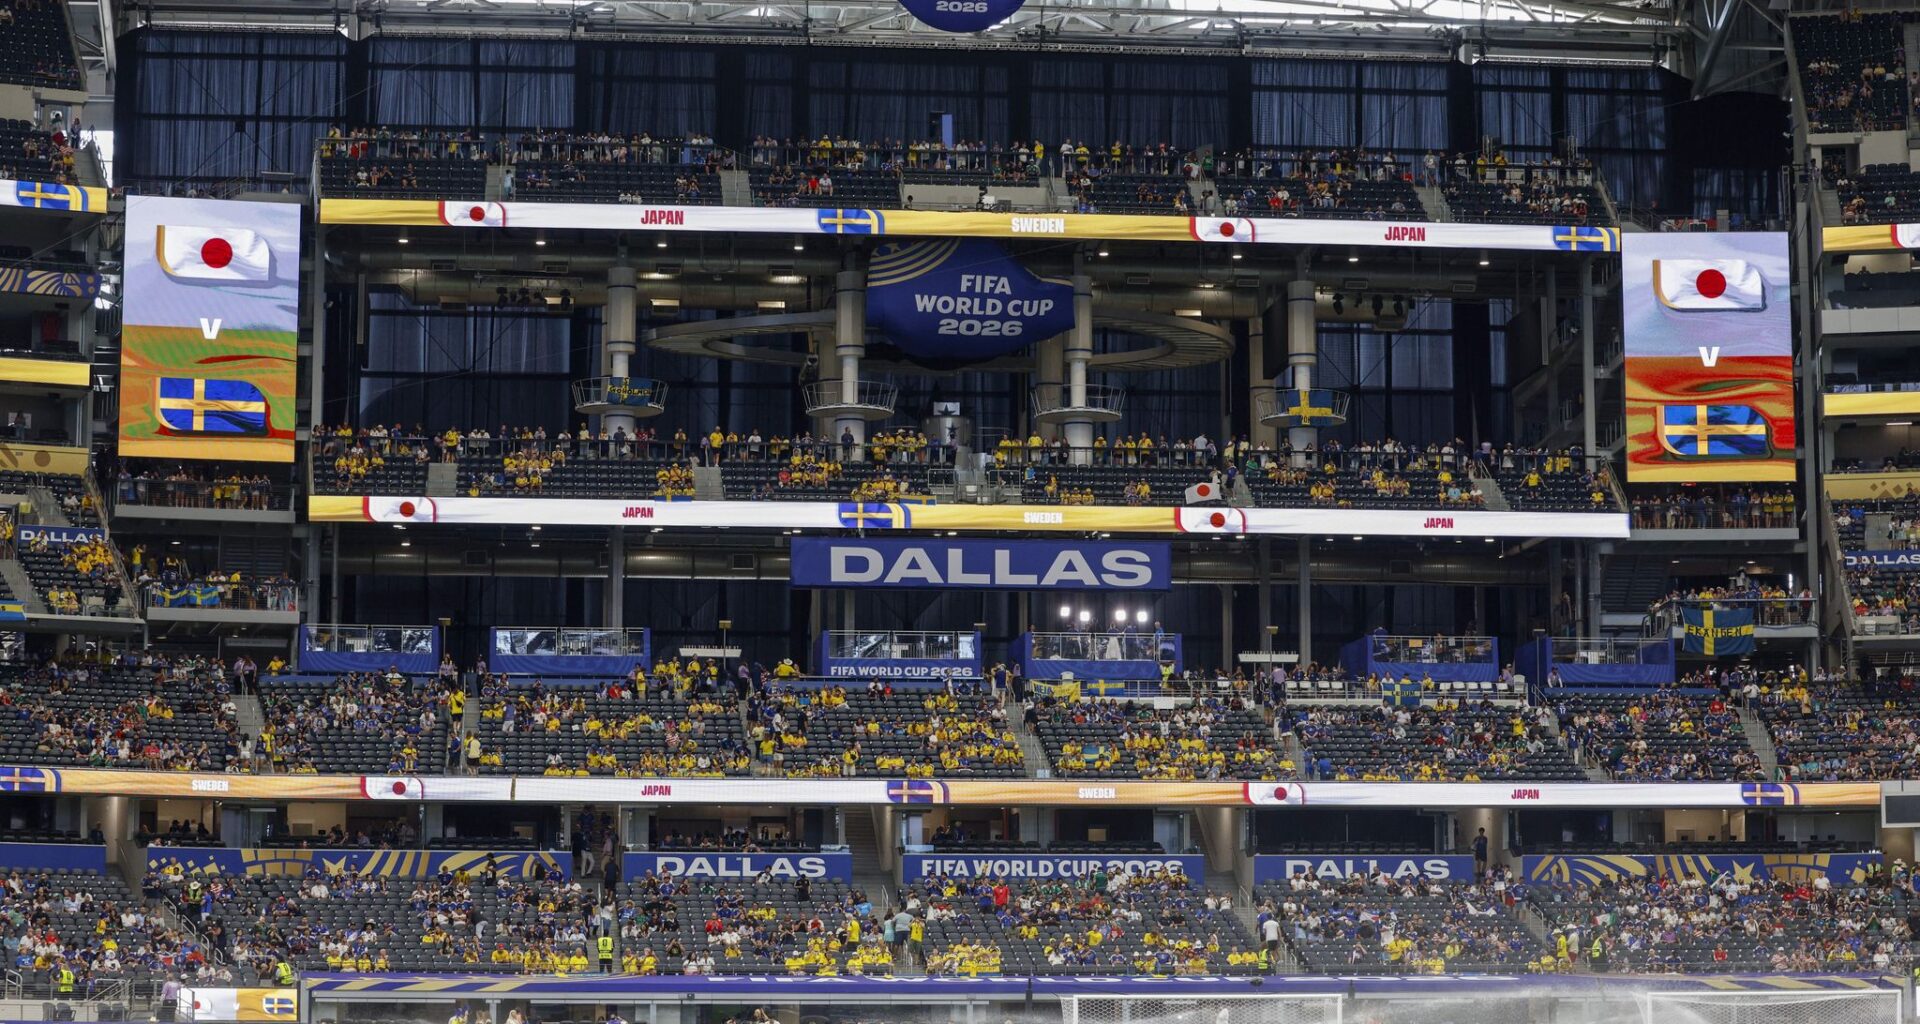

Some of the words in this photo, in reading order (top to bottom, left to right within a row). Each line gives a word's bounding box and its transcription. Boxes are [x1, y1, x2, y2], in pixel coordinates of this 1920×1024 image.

[936, 1, 988, 13] 2026
[641, 210, 684, 225] JAPAN
[1012, 218, 1065, 233] SWEDEN
[1385, 226, 1426, 242] JAPAN
[960, 275, 1012, 295] FIFA
[915, 294, 1003, 316] WORLD
[1007, 299, 1054, 317] CUP
[938, 318, 1023, 337] 2026
[622, 506, 654, 518] JAPAN
[1023, 512, 1063, 524] SWEDEN
[1423, 518, 1454, 529] JAPAN
[1844, 553, 1920, 566] DALLAS
[829, 546, 1153, 588] DALLAS
[830, 666, 857, 677] FIFA
[859, 666, 903, 677] WORLD
[904, 666, 929, 677] CUP
[930, 667, 973, 677] 2026
[191, 780, 229, 792] SWEDEN
[641, 785, 671, 796] JAPAN
[1078, 787, 1116, 799] SWEDEN
[1511, 789, 1540, 800] JAPAN
[656, 856, 826, 878] DALLAS
[921, 859, 970, 876] FIFA
[973, 859, 1055, 877] WORLD
[1057, 860, 1102, 877] CUP
[1106, 860, 1184, 877] 2026
[1285, 859, 1450, 880] DALLAS
[863, 975, 1121, 983] WORLD
